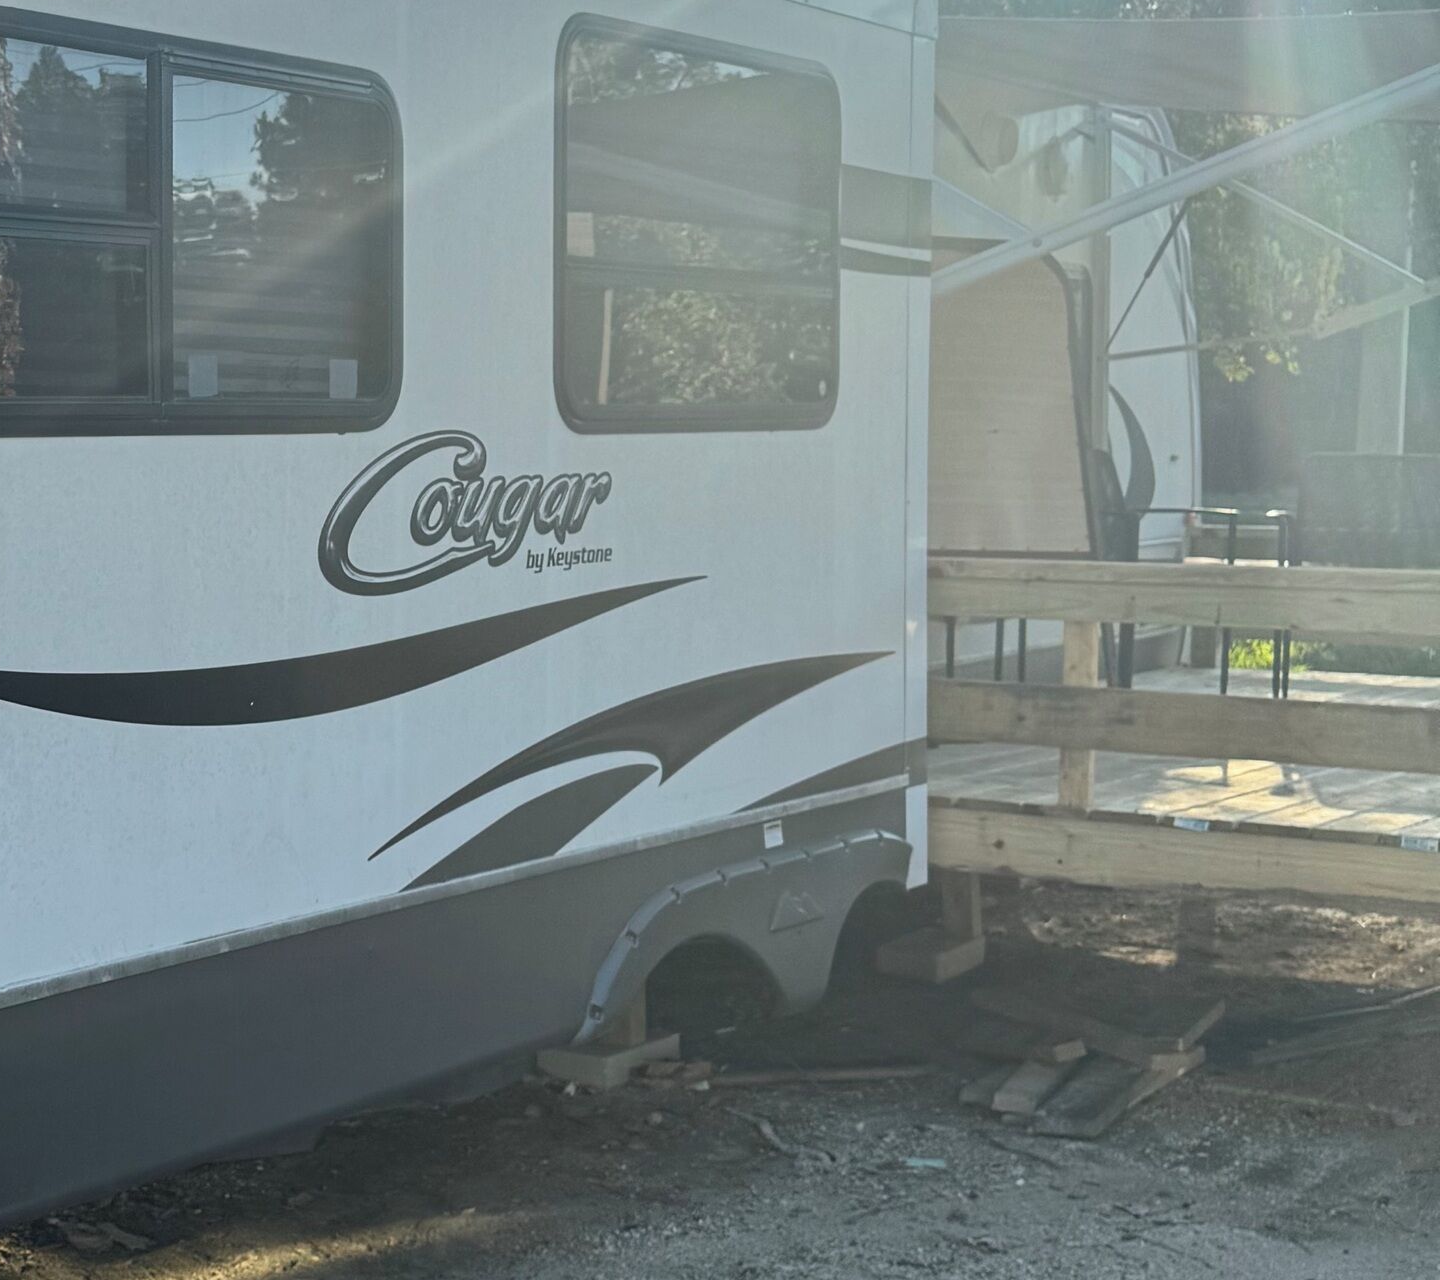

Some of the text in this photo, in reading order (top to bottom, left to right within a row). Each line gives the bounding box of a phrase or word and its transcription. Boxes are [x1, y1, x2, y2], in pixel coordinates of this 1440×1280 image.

[318, 430, 611, 596] Cougar
[526, 547, 612, 573] by Keystone
